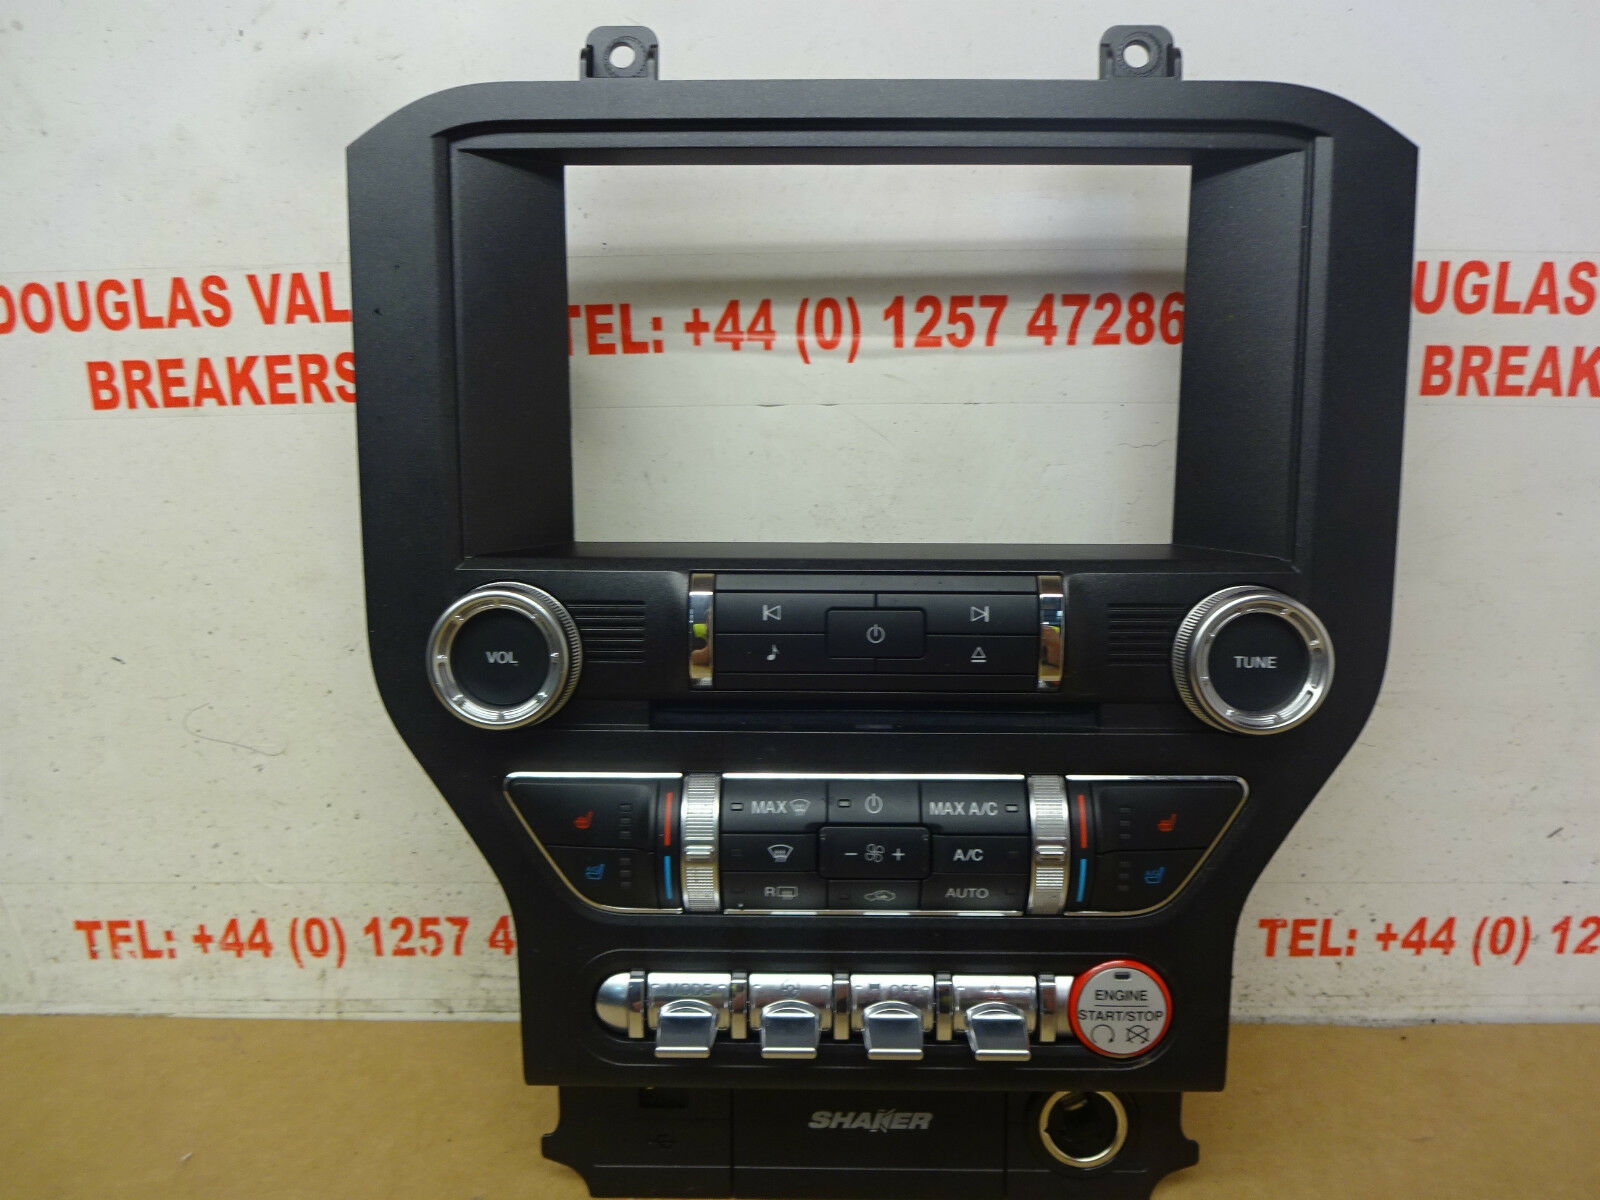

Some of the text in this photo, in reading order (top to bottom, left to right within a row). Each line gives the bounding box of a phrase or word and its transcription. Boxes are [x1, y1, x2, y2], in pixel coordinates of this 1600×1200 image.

[245, 271, 353, 325] VAL
[684, 299, 776, 351] +44
[796, 297, 861, 364] (0)
[883, 295, 1008, 348] 1257
[1026, 292, 1184, 346] 47286
[1419, 345, 1600, 397] BREAK
[86, 352, 356, 411] BREAKERS
[486, 651, 519, 664] VOL
[1233, 656, 1278, 669] TUNE
[751, 801, 787, 815] MAX
[929, 802, 999, 816] MAX A/C
[953, 849, 984, 862] A/C
[945, 887, 989, 899] AUTO
[74, 915, 515, 968] TEL: +44 (0) 1257 4
[1258, 915, 1600, 966] TEL: +44 (0) 12
[1095, 990, 1148, 1001] ENGINE
[1078, 1009, 1163, 1021] START/STOP
[808, 1109, 933, 1132] SHAKER
